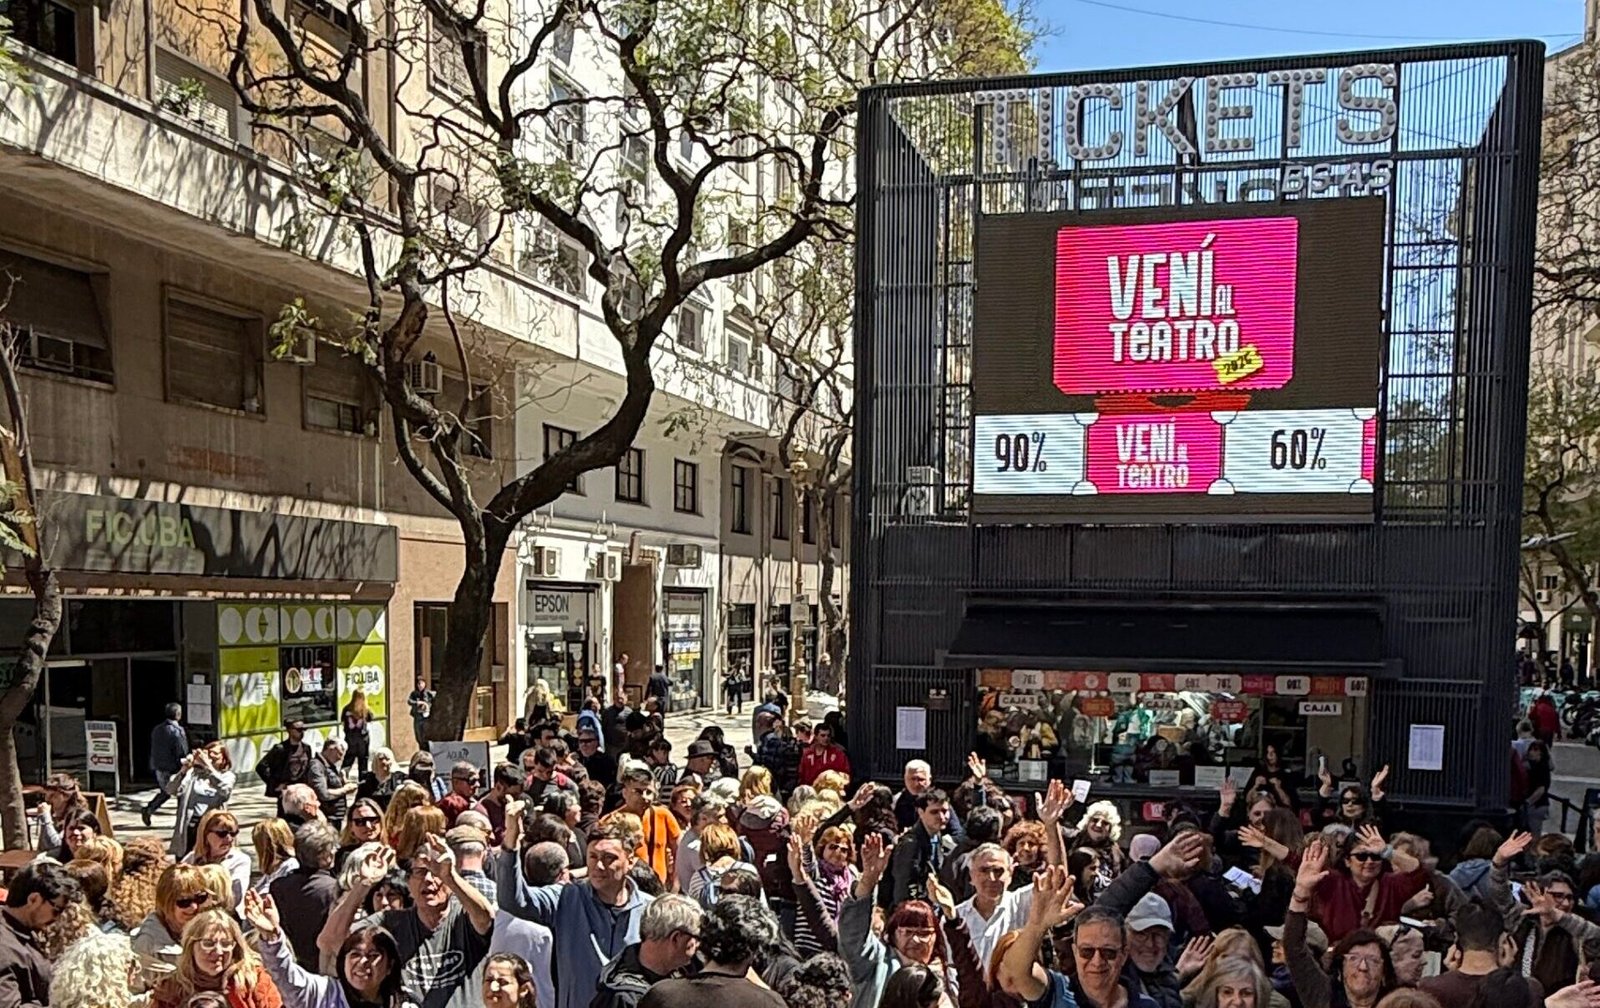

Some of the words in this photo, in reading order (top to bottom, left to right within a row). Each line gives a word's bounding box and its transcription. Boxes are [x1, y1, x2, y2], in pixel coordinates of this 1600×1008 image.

[974, 62, 1398, 163] TICKETS
[1106, 232, 1216, 320] VENÍ
[1216, 284, 1236, 315] AL
[995, 431, 1047, 473] 90%
[1116, 416, 1176, 463] VENÍ
[1270, 427, 1327, 470] 60%
[535, 594, 570, 613] EPSON
[1002, 696, 1027, 705] CAJA
[1146, 700, 1171, 709] CAJA
[1303, 704, 1332, 712] CAJA
